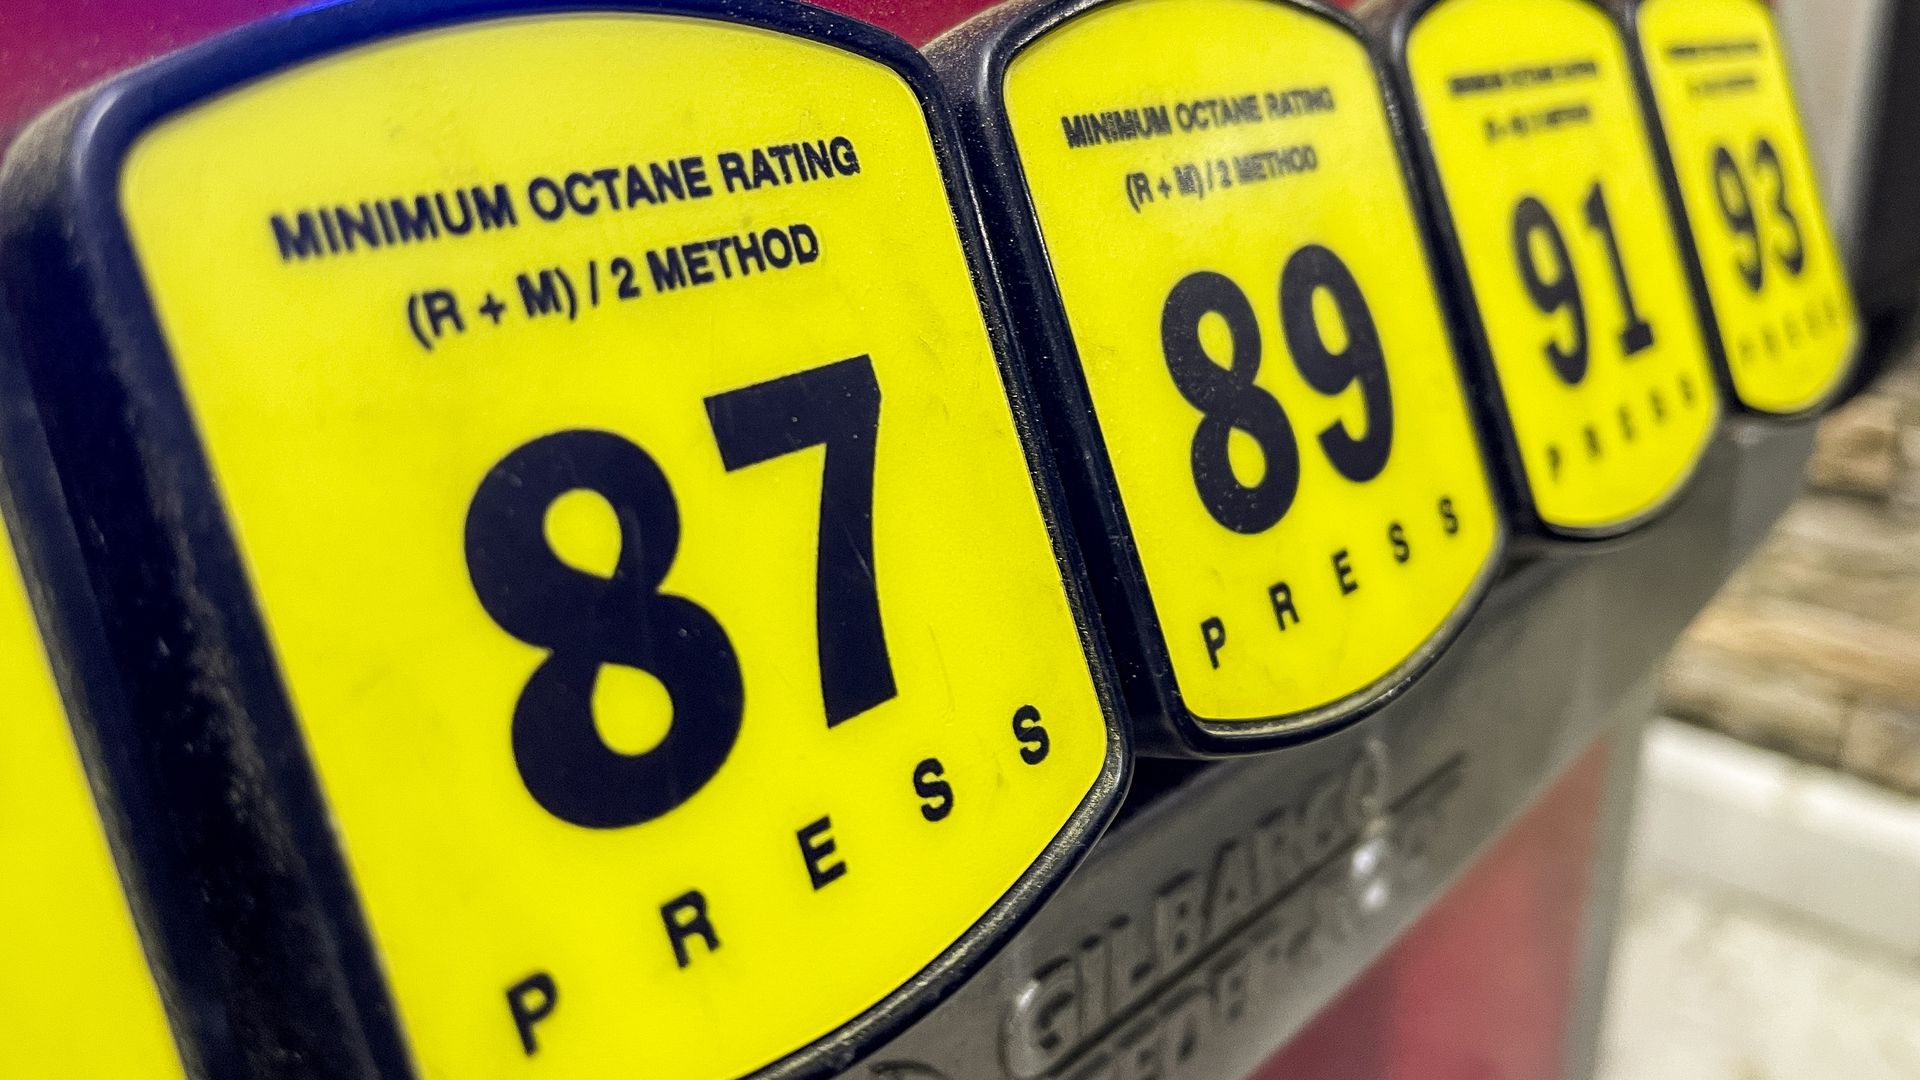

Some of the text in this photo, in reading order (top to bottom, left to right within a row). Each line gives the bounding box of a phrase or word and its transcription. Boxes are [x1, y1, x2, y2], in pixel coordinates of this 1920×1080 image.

[1061, 86, 1335, 148] MINIMUM OCTANE RATING
[1125, 171, 1154, 213] (R
[1158, 177, 1172, 198] +
[1217, 160, 1233, 189] 2
[1234, 145, 1319, 183] METHOD
[270, 136, 861, 262] MINIMUM OCTANE RATING
[1712, 138, 1806, 294] 93
[407, 224, 819, 351] (R + M) / 2 METHOD
[1512, 181, 1655, 387] 91
[1160, 244, 1394, 535] 89
[463, 354, 897, 830] 87
